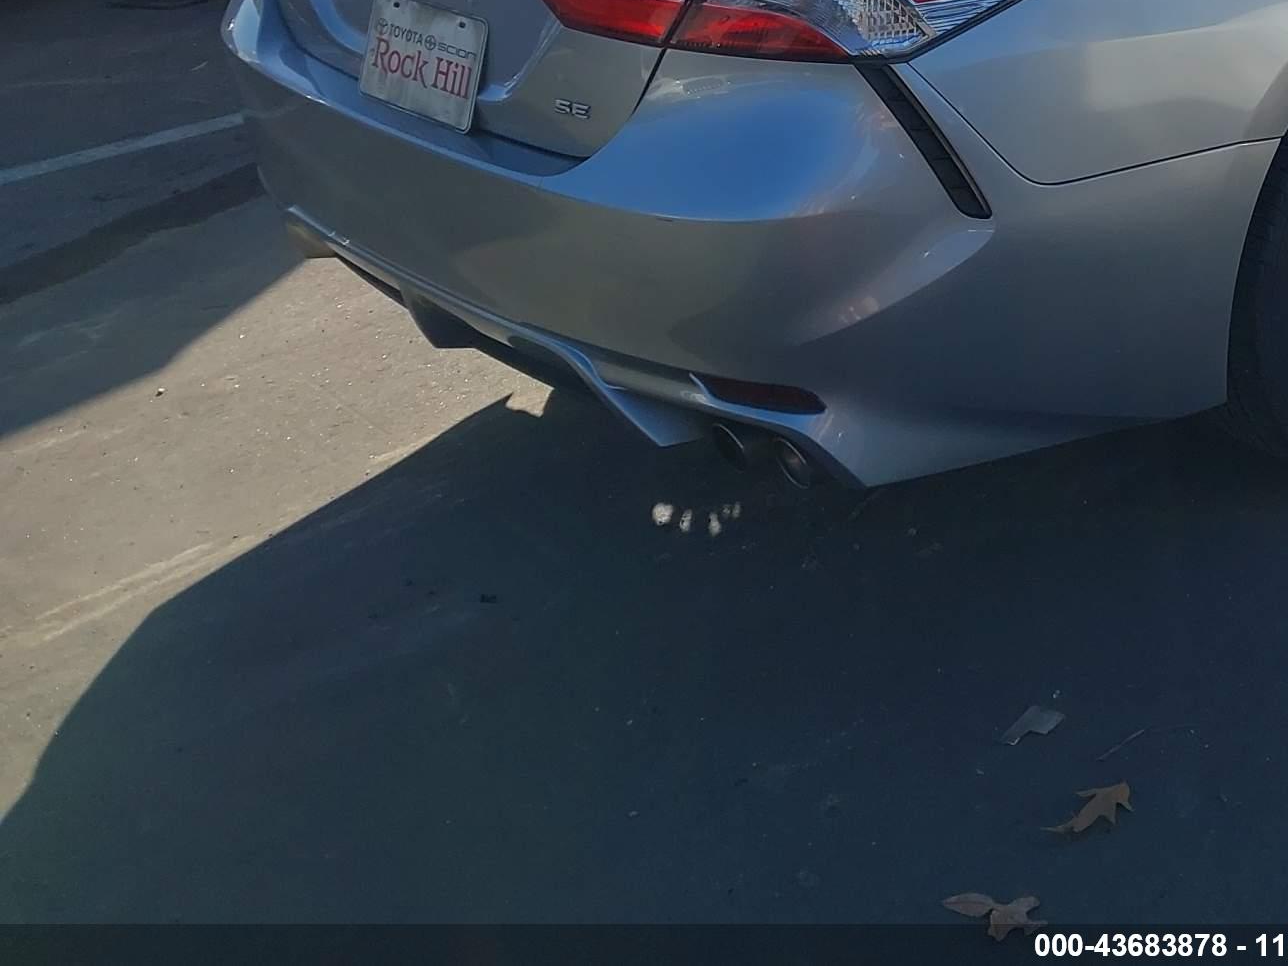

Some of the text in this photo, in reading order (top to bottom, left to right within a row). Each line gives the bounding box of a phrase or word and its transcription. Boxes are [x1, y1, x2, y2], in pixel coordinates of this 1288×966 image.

[389, 23, 424, 46] TOYOTA
[371, 36, 473, 100] Rock Hill
[554, 99, 591, 120] SE
